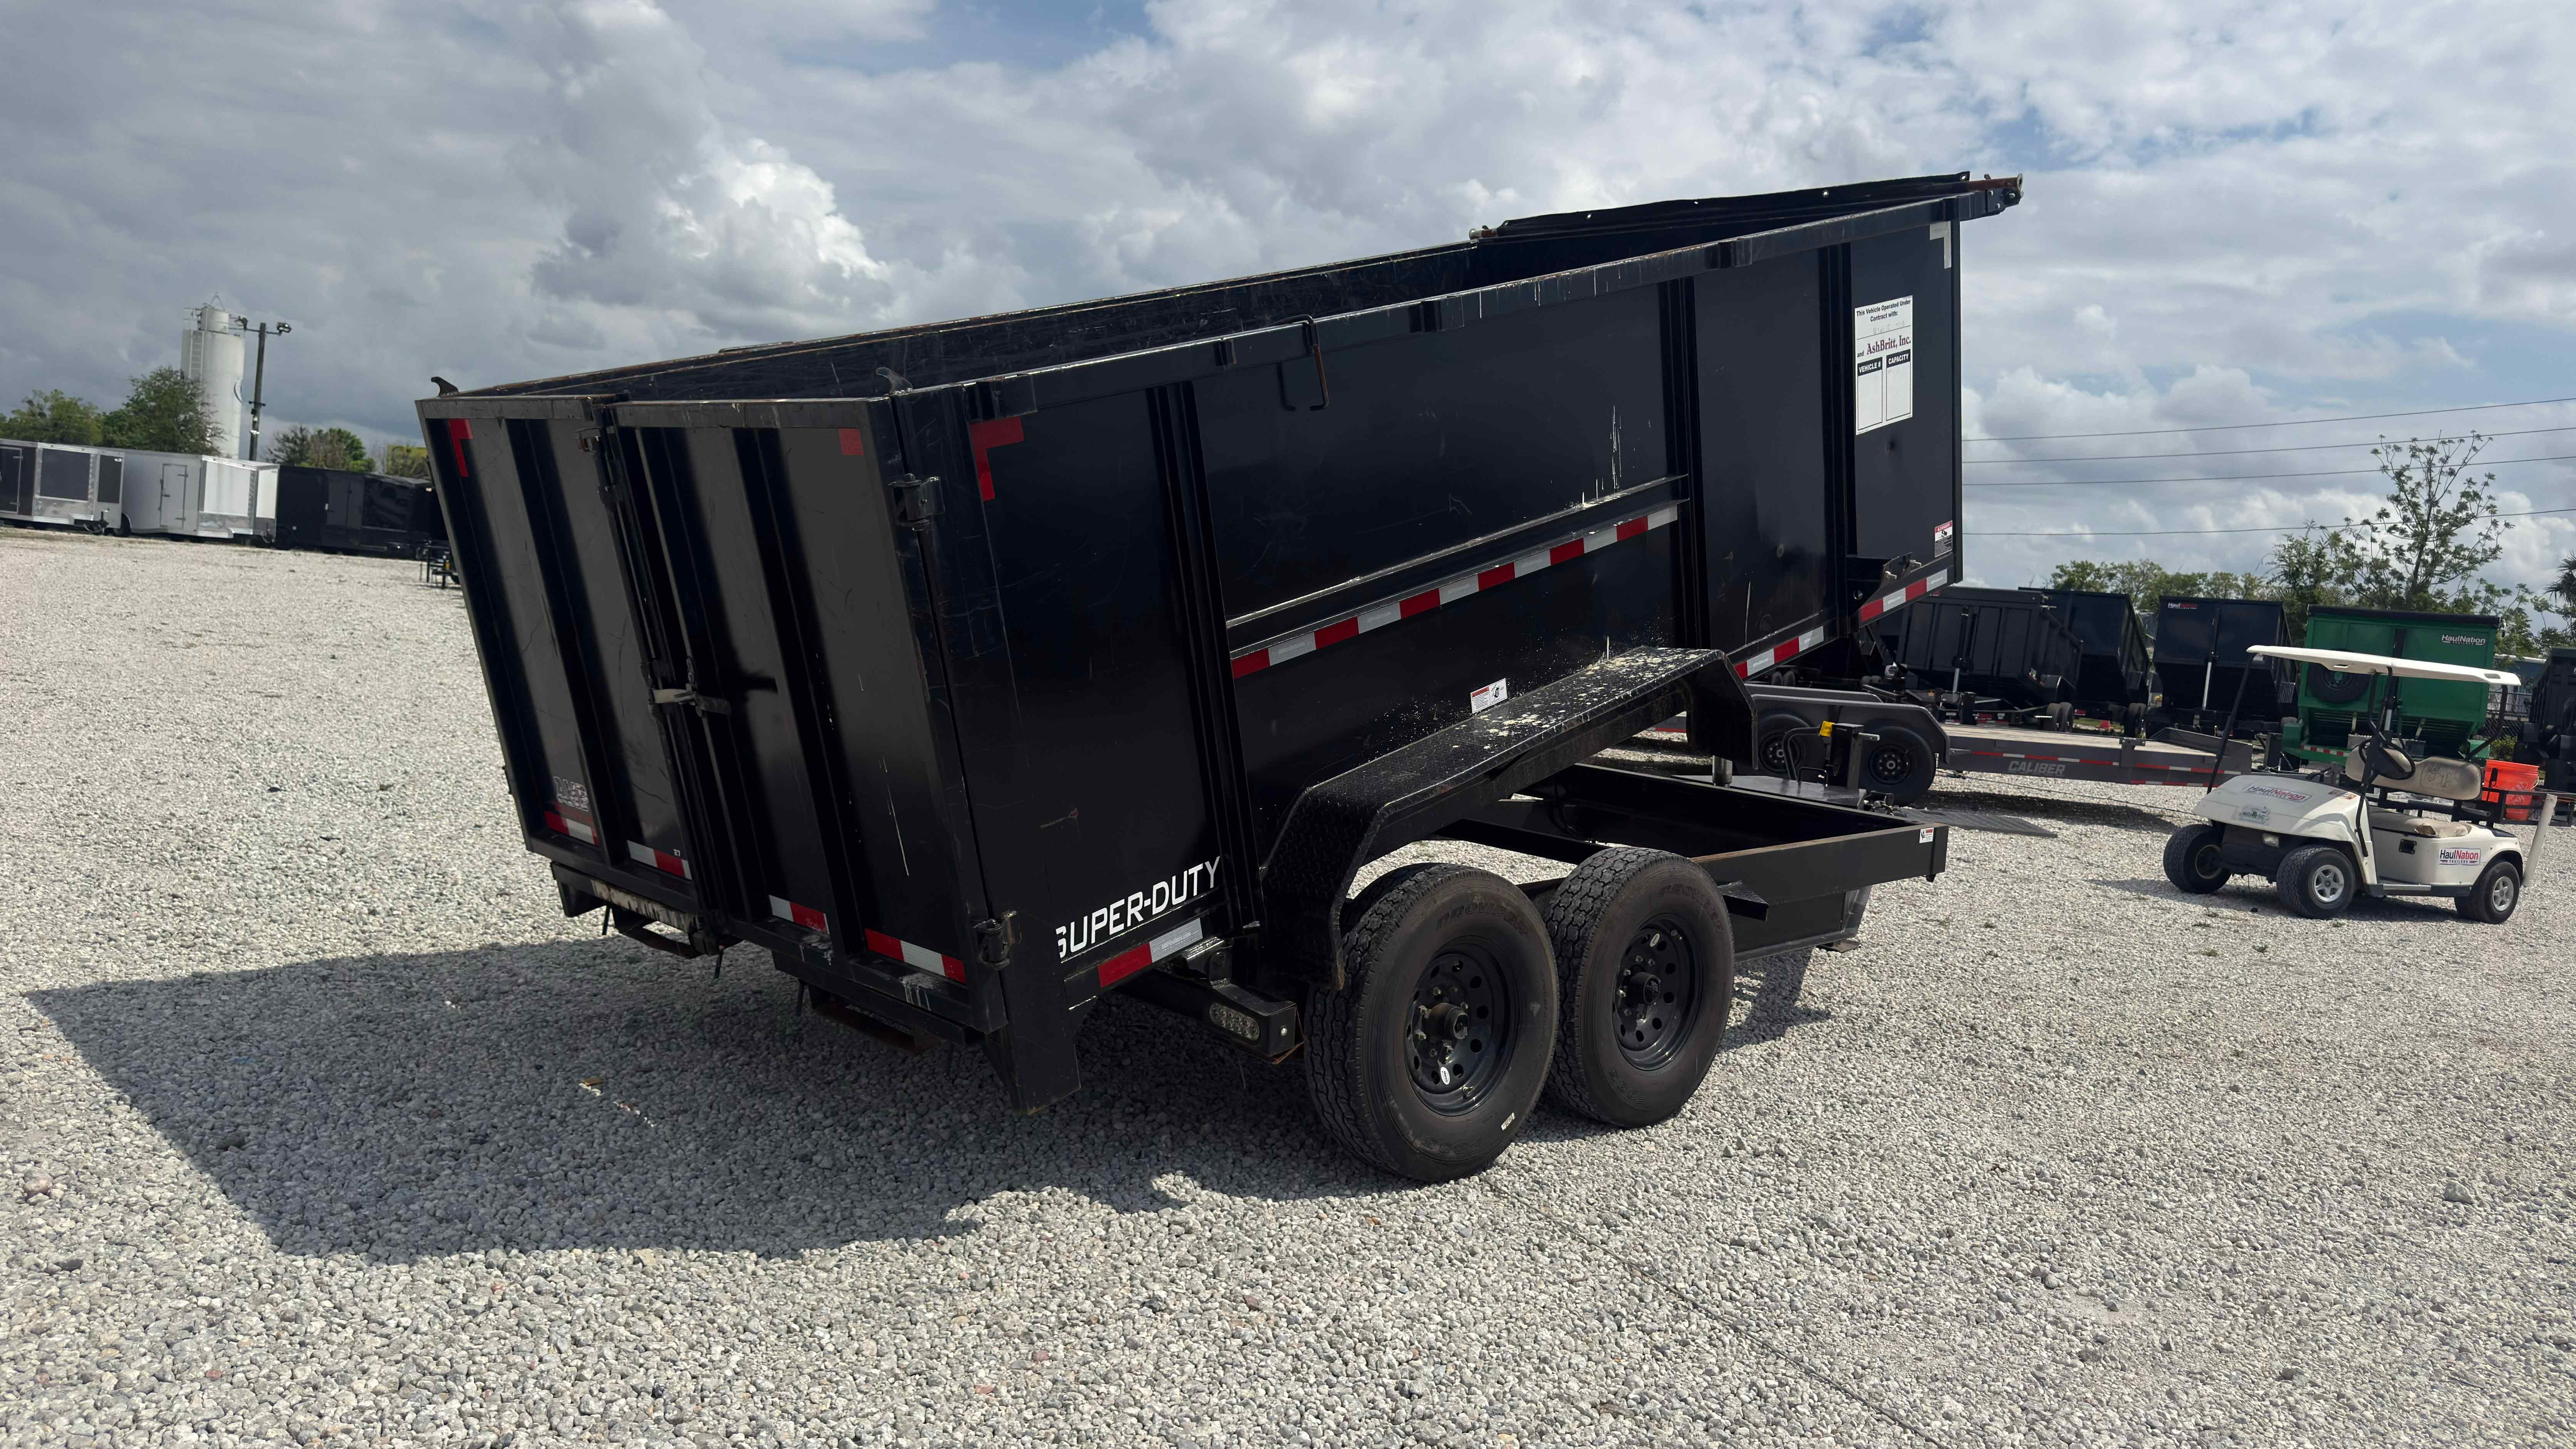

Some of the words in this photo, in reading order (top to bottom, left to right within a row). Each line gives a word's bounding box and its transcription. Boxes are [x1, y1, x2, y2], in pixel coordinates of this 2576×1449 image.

[1882, 302, 1899, 311] Operated
[1870, 313, 1887, 322] Contract
[1867, 338, 1897, 354] AshBritt,
[1899, 335, 1911, 346] Inc.
[1888, 354, 1909, 364] CAPACITY
[1859, 363, 1877, 373] VEHICLE
[2442, 634, 2485, 644] HaulNation
[2008, 760, 2066, 775] CALIBER
[2248, 786, 2306, 800] HaulNation
[2440, 849, 2478, 860] HaulNation
[1056, 856, 1220, 958] SUPER-DUTY
